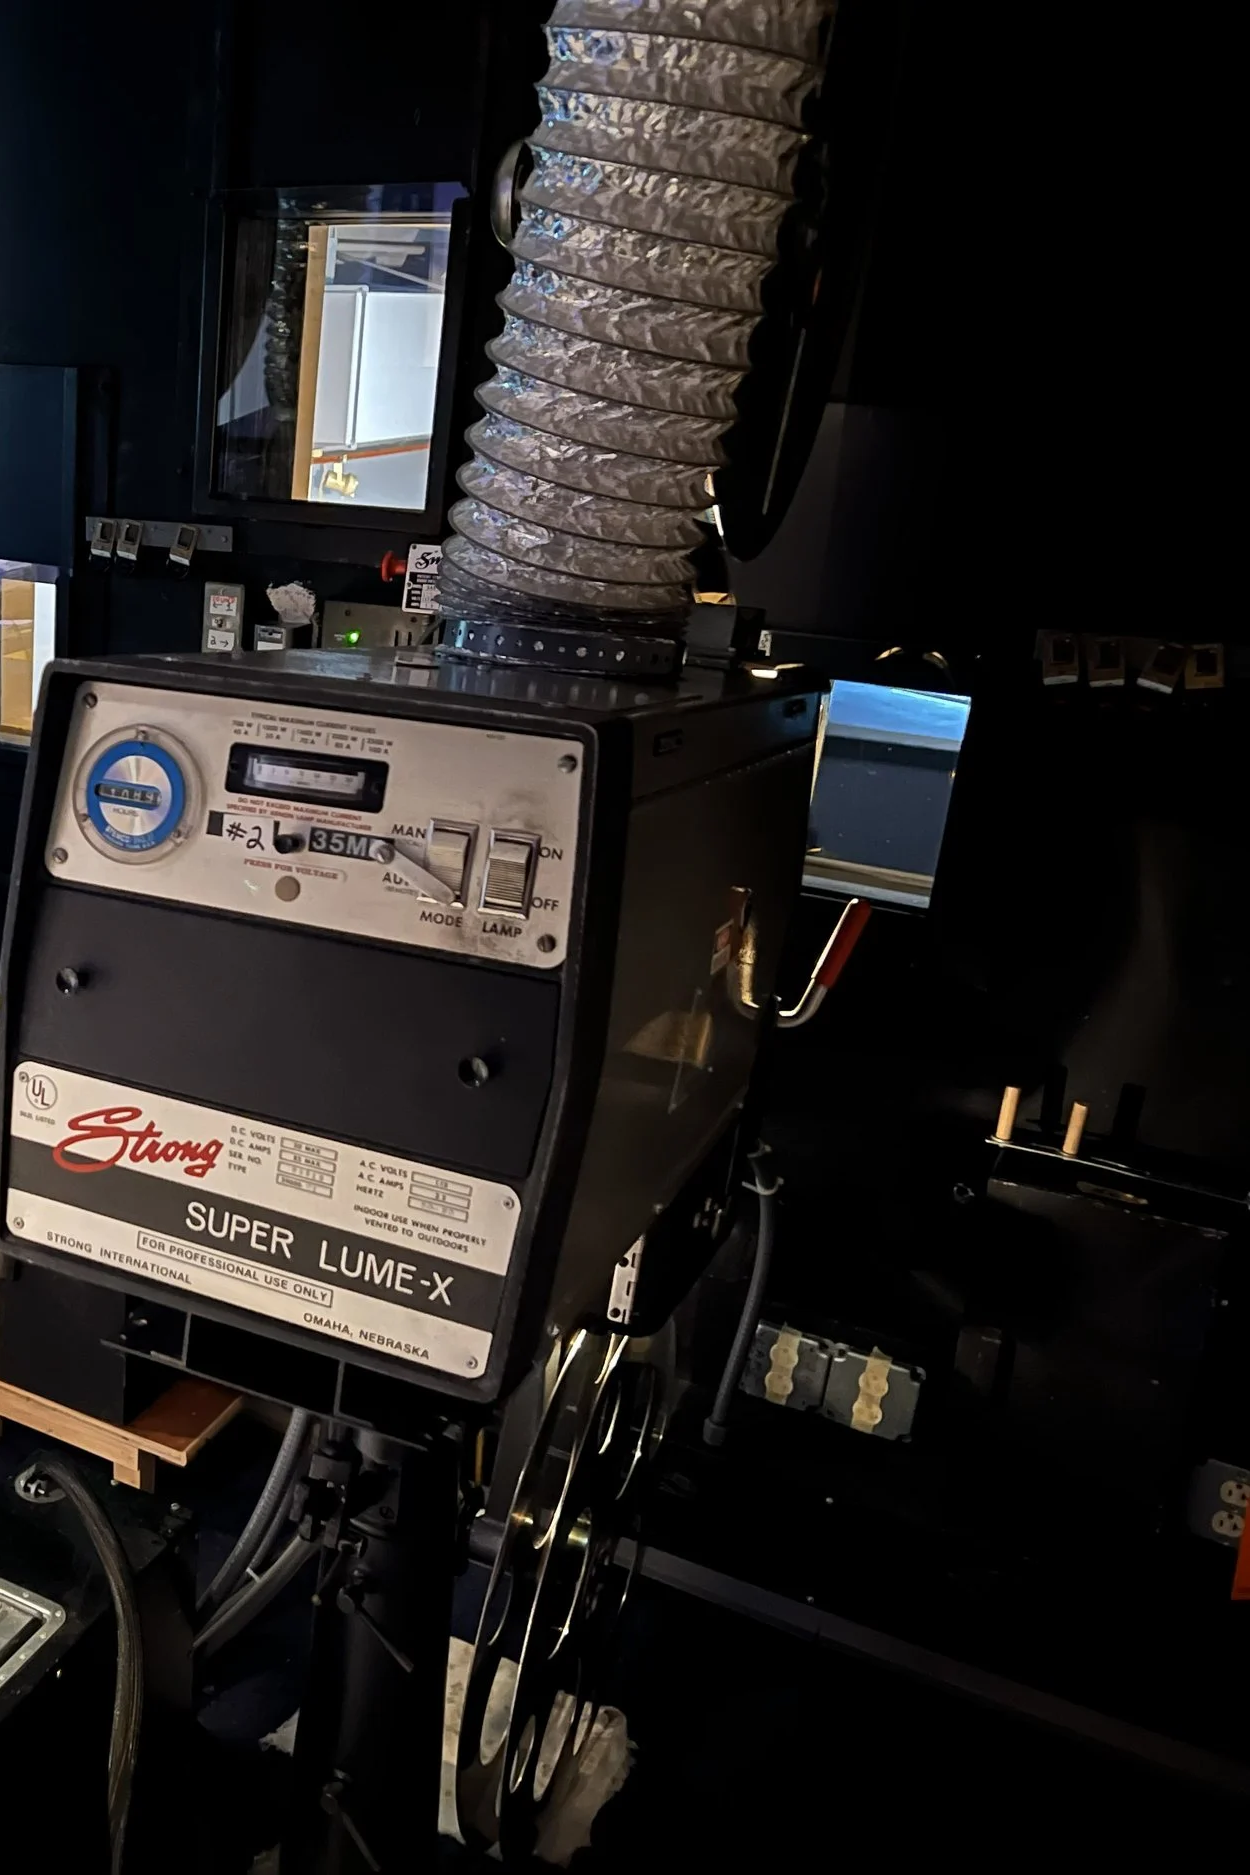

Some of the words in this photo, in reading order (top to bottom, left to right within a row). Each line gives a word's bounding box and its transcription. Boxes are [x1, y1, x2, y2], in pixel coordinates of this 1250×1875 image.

[112, 807, 140, 817] HOURS
[266, 801, 291, 811] EXCEED
[293, 805, 329, 816] MAXIMUM
[330, 811, 362, 821] CURRENT
[226, 821, 265, 851] #2
[539, 847, 563, 860] ON
[244, 858, 272, 870] PRESS
[274, 862, 294, 873] FOR
[295, 866, 339, 881] VOLTAGE
[531, 897, 560, 911] OFF
[419, 911, 464, 928] MODE
[482, 921, 523, 938] LAMP
[53, 1106, 224, 1179] Strong
[250, 1130, 275, 1144] VOLTS
[248, 1142, 272, 1155] AMPS
[228, 1162, 247, 1174] TYPE
[380, 1164, 408, 1179] VOLTS
[356, 1184, 384, 1198] HERTZ
[379, 1177, 404, 1191] AMPS
[353, 1204, 389, 1219] INDOOR
[391, 1214, 408, 1225] USE
[411, 1219, 440, 1233] WHEN
[442, 1228, 487, 1246] PROPERLY
[364, 1217, 399, 1233] VENTED
[401, 1227, 414, 1238] TO
[417, 1232, 469, 1254] OUTDOORS
[46, 1231, 94, 1254] STRONG
[99, 1247, 193, 1286] INTERNATIONAL
[184, 1200, 295, 1260] SUPER
[317, 1239, 455, 1307] LUME-X
[141, 1235, 167, 1253] FOR
[168, 1243, 260, 1282] PROFESSIONAL
[262, 1272, 291, 1291] USE
[291, 1281, 330, 1303] ONLY
[303, 1311, 354, 1338] OMAHA,
[358, 1327, 431, 1361] NEBRASKA
